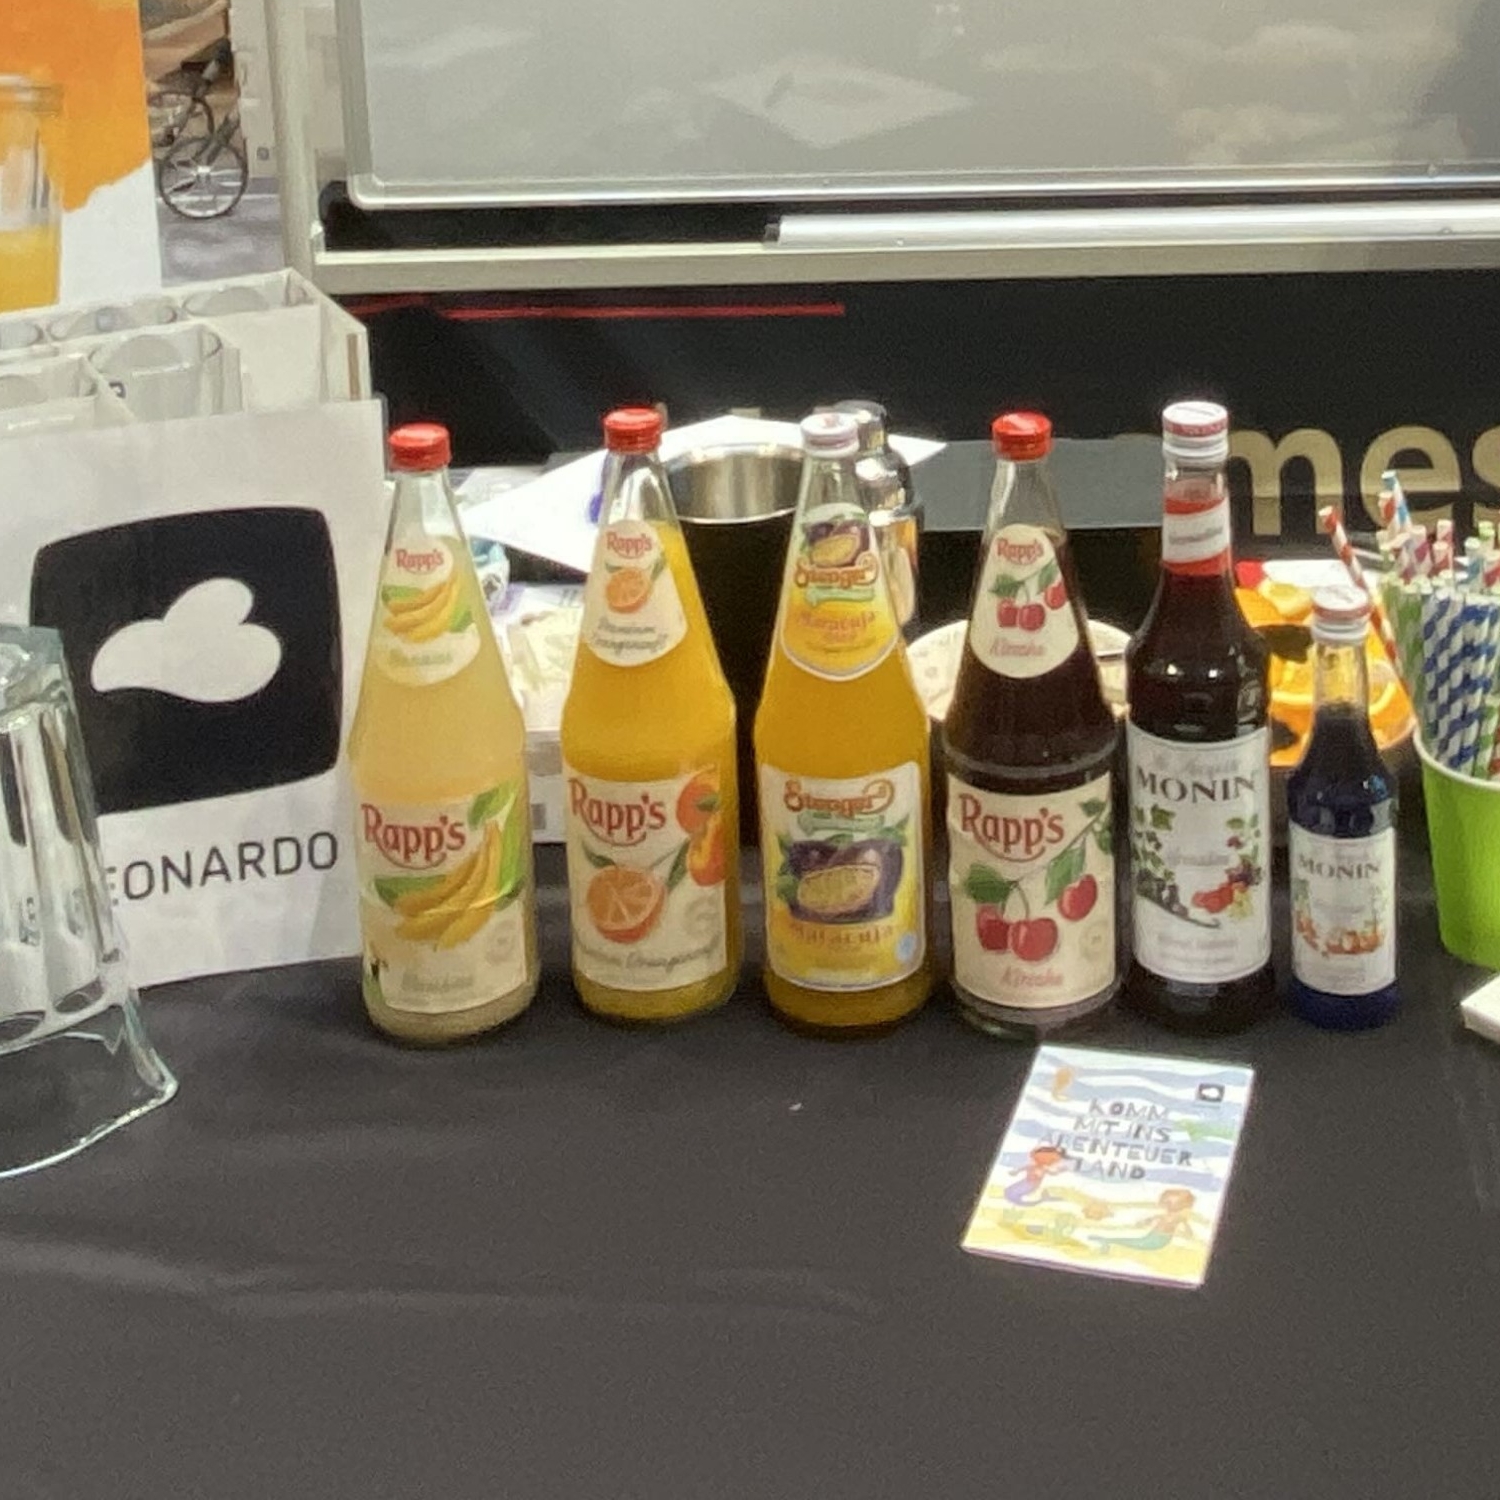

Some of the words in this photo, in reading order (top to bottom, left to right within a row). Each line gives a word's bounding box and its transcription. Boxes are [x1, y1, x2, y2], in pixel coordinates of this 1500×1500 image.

[605, 531, 653, 560] Rapp's
[996, 536, 1045, 566] Rapp's
[395, 547, 445, 575] Rapp's
[1136, 764, 1256, 803] MONIN
[567, 777, 667, 847] Rapp's
[361, 802, 466, 871] Rapp's
[958, 792, 1065, 863] Rapp's
[1299, 853, 1380, 880] MONIN
[1088, 1099, 1171, 1122] KOMM
[1072, 1115, 1121, 1137] MIT
[1071, 1156, 1147, 1181] LAND
